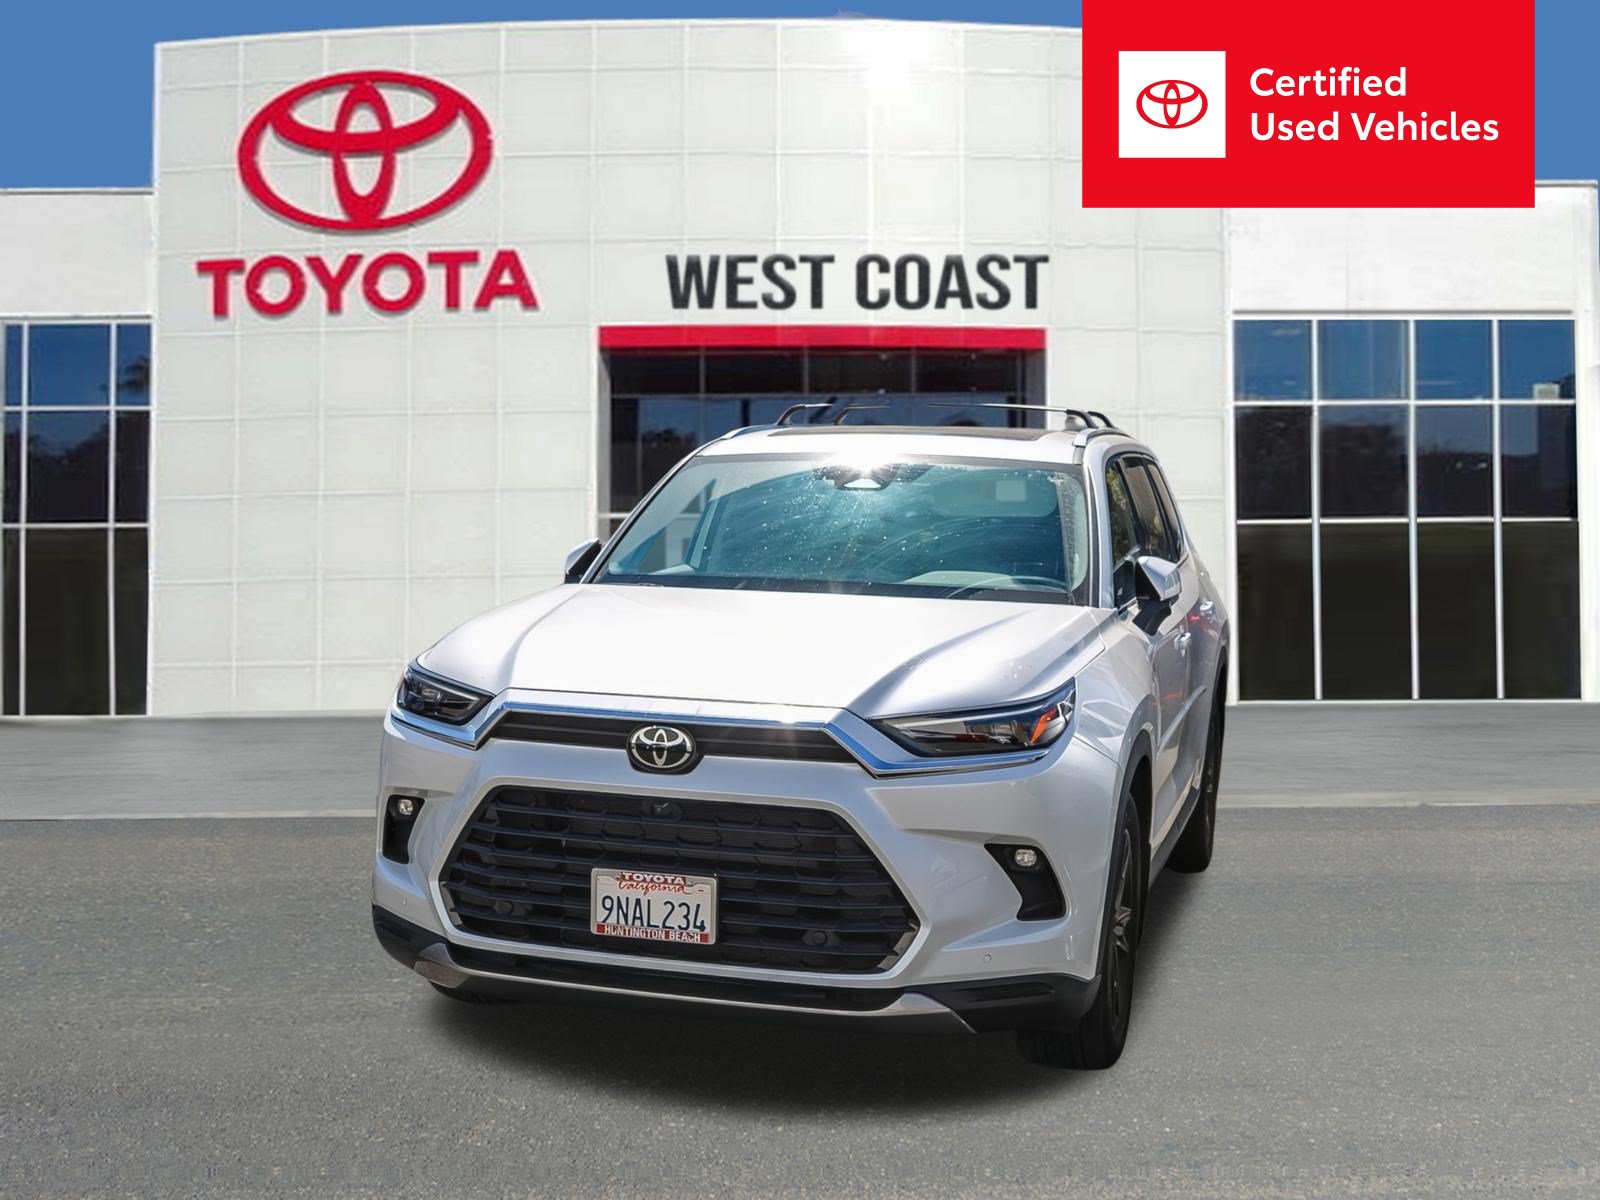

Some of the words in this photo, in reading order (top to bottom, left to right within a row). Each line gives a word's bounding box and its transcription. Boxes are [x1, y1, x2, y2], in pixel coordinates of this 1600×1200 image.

[196, 249, 538, 317] TOYOTA
[665, 254, 835, 310] WEST
[855, 254, 1050, 310] COAST
[621, 872, 685, 884] TOYOTA
[601, 895, 706, 932] 9NAL234
[604, 925, 666, 940] HUNTINGTON
[669, 931, 701, 943] BEACH
